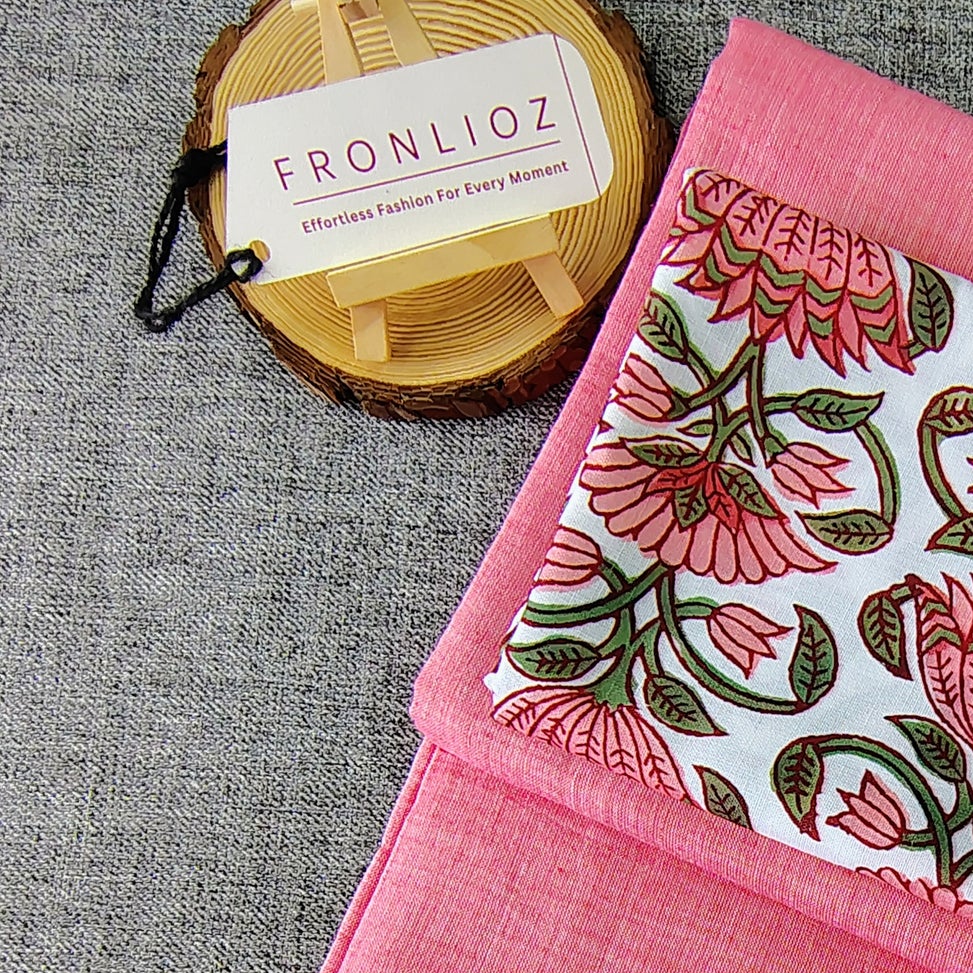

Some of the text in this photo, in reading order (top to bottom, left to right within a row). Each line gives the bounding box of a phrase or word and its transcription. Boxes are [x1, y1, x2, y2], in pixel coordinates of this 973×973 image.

[273, 96, 557, 191] FRONLIOZ
[301, 159, 571, 235] Effortless Fashion For Every Moment
